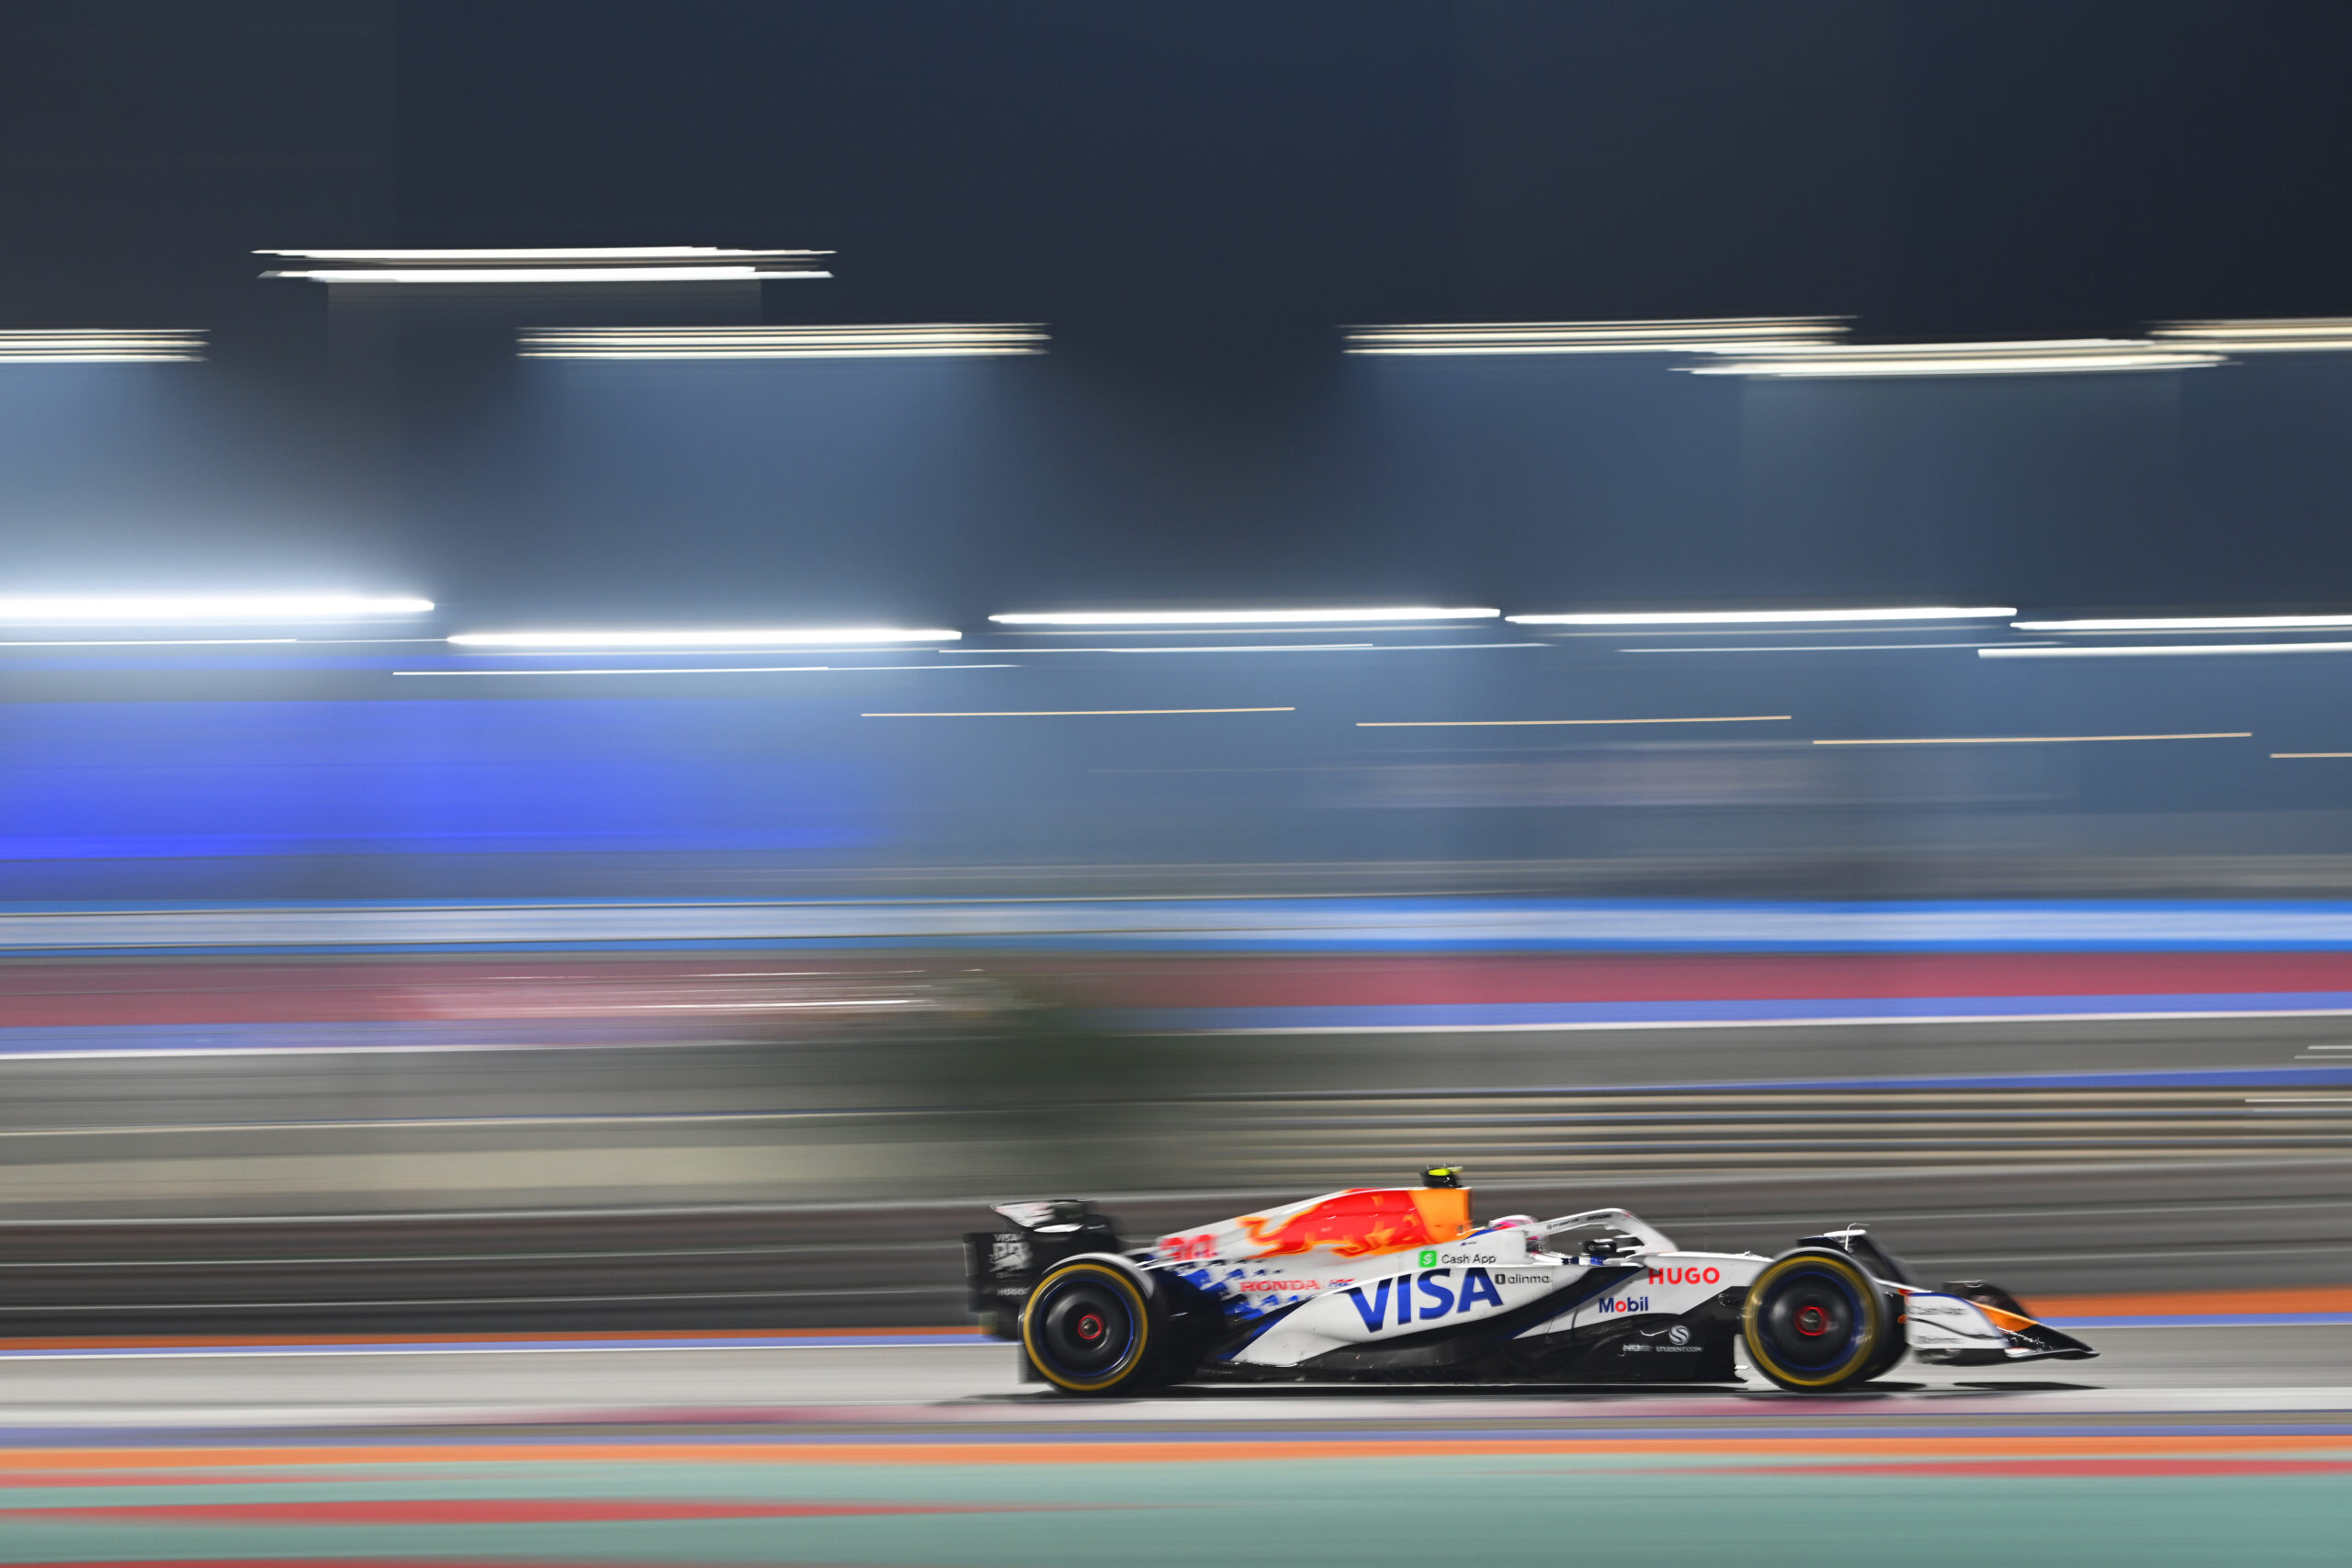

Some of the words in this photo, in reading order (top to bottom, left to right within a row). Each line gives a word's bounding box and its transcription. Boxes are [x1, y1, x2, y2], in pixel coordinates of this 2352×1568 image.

[1442, 1255, 1469, 1264] Cash
[1473, 1254, 1496, 1265] App
[1648, 1268, 1720, 1285] HUGO
[996, 1288, 1028, 1296] HUGO
[1239, 1280, 1321, 1292] HONDA
[1348, 1267, 1504, 1333] VISA
[1599, 1296, 1649, 1314] Mobil
